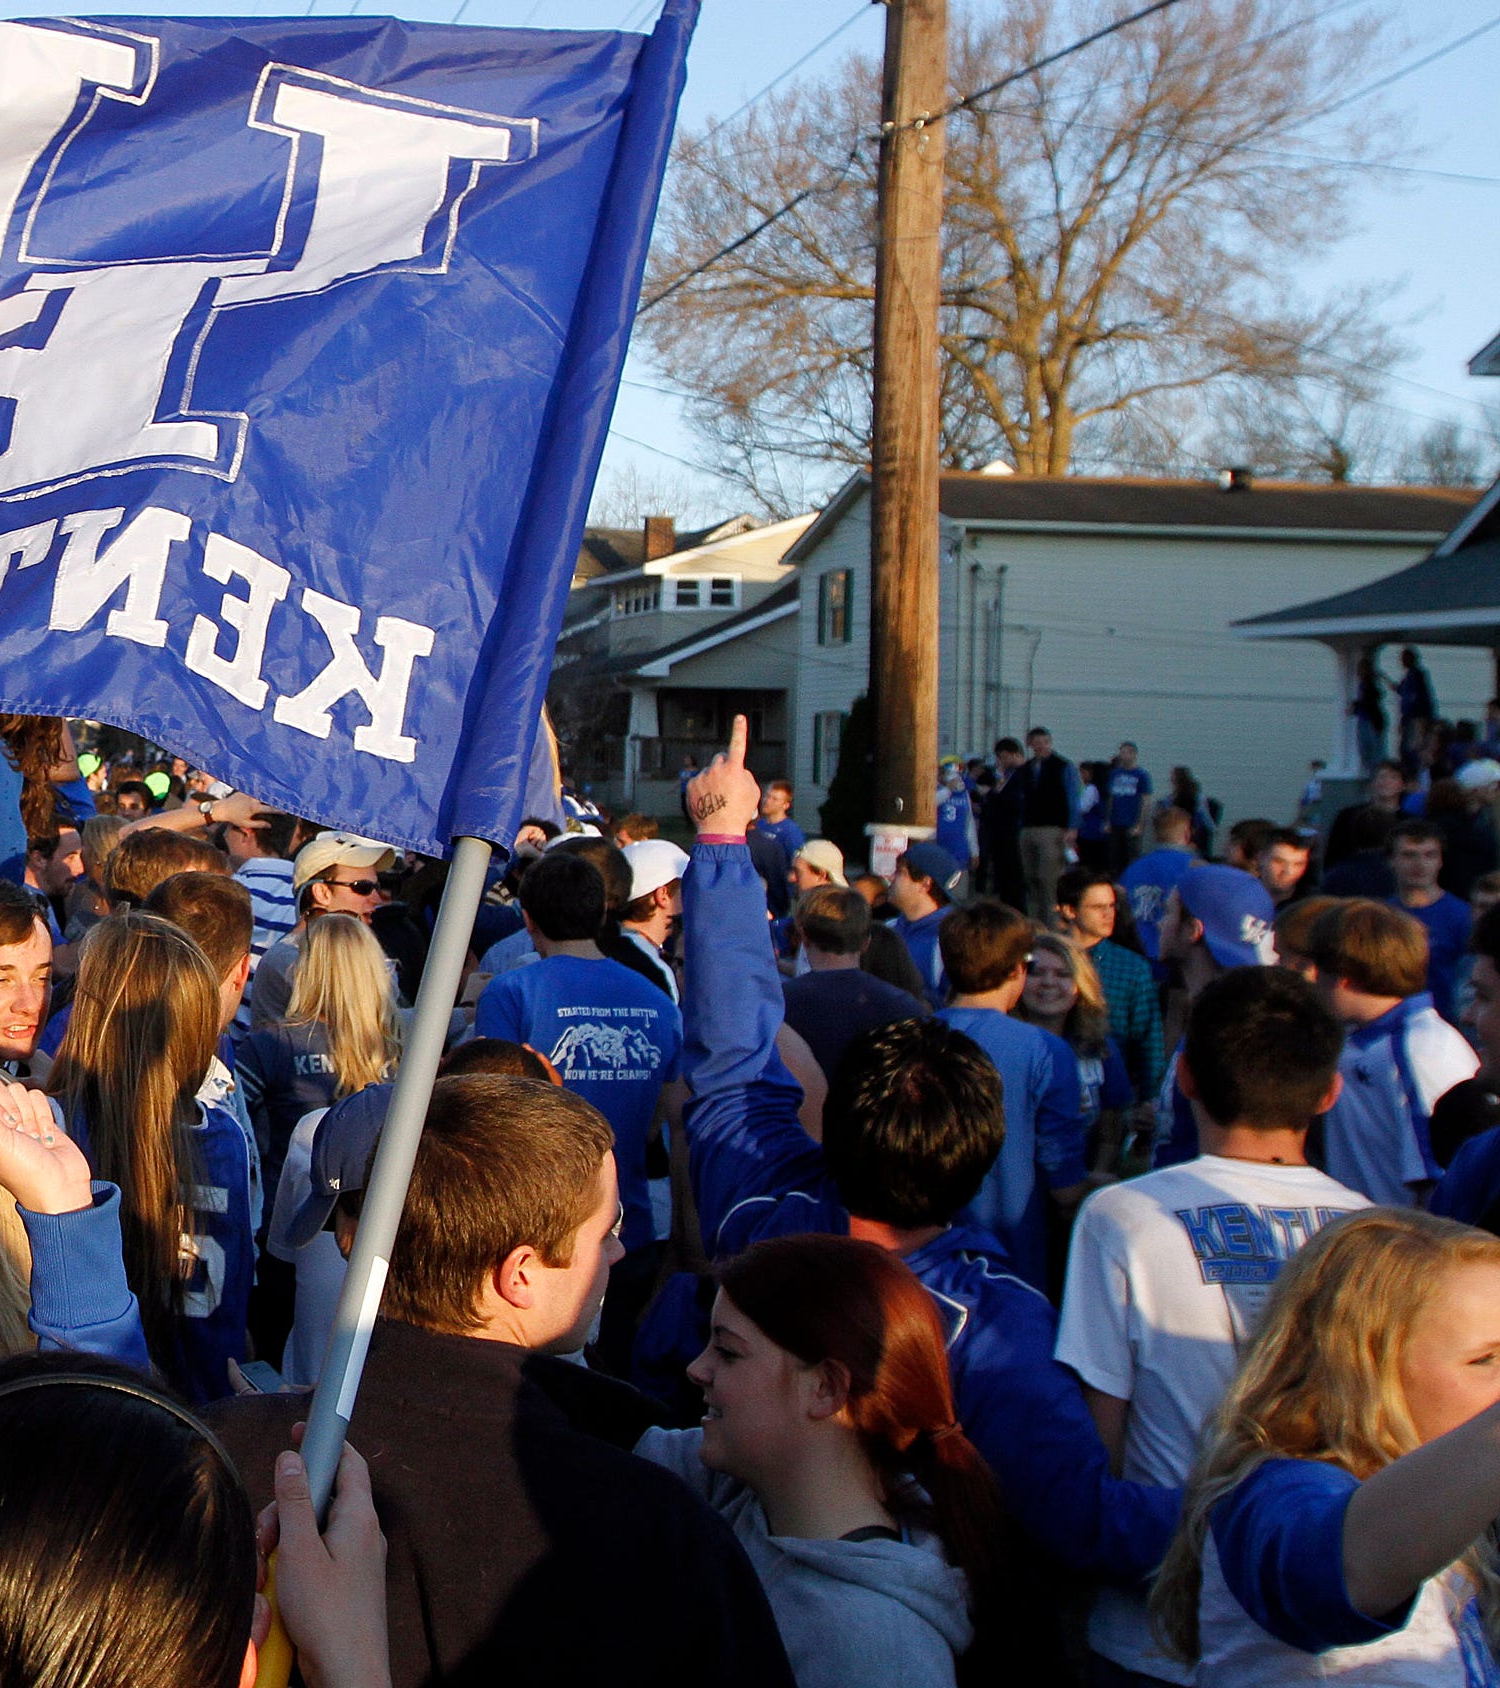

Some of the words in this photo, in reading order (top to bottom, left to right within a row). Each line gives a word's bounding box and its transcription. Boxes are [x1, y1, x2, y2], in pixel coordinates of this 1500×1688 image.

[557, 1008, 591, 1018] STARTED
[592, 1007, 611, 1017] FROM
[613, 1008, 629, 1017] THE
[630, 1008, 659, 1018] BOTTOM
[564, 1070, 587, 1080] NOW
[587, 1069, 614, 1080] WE'RE
